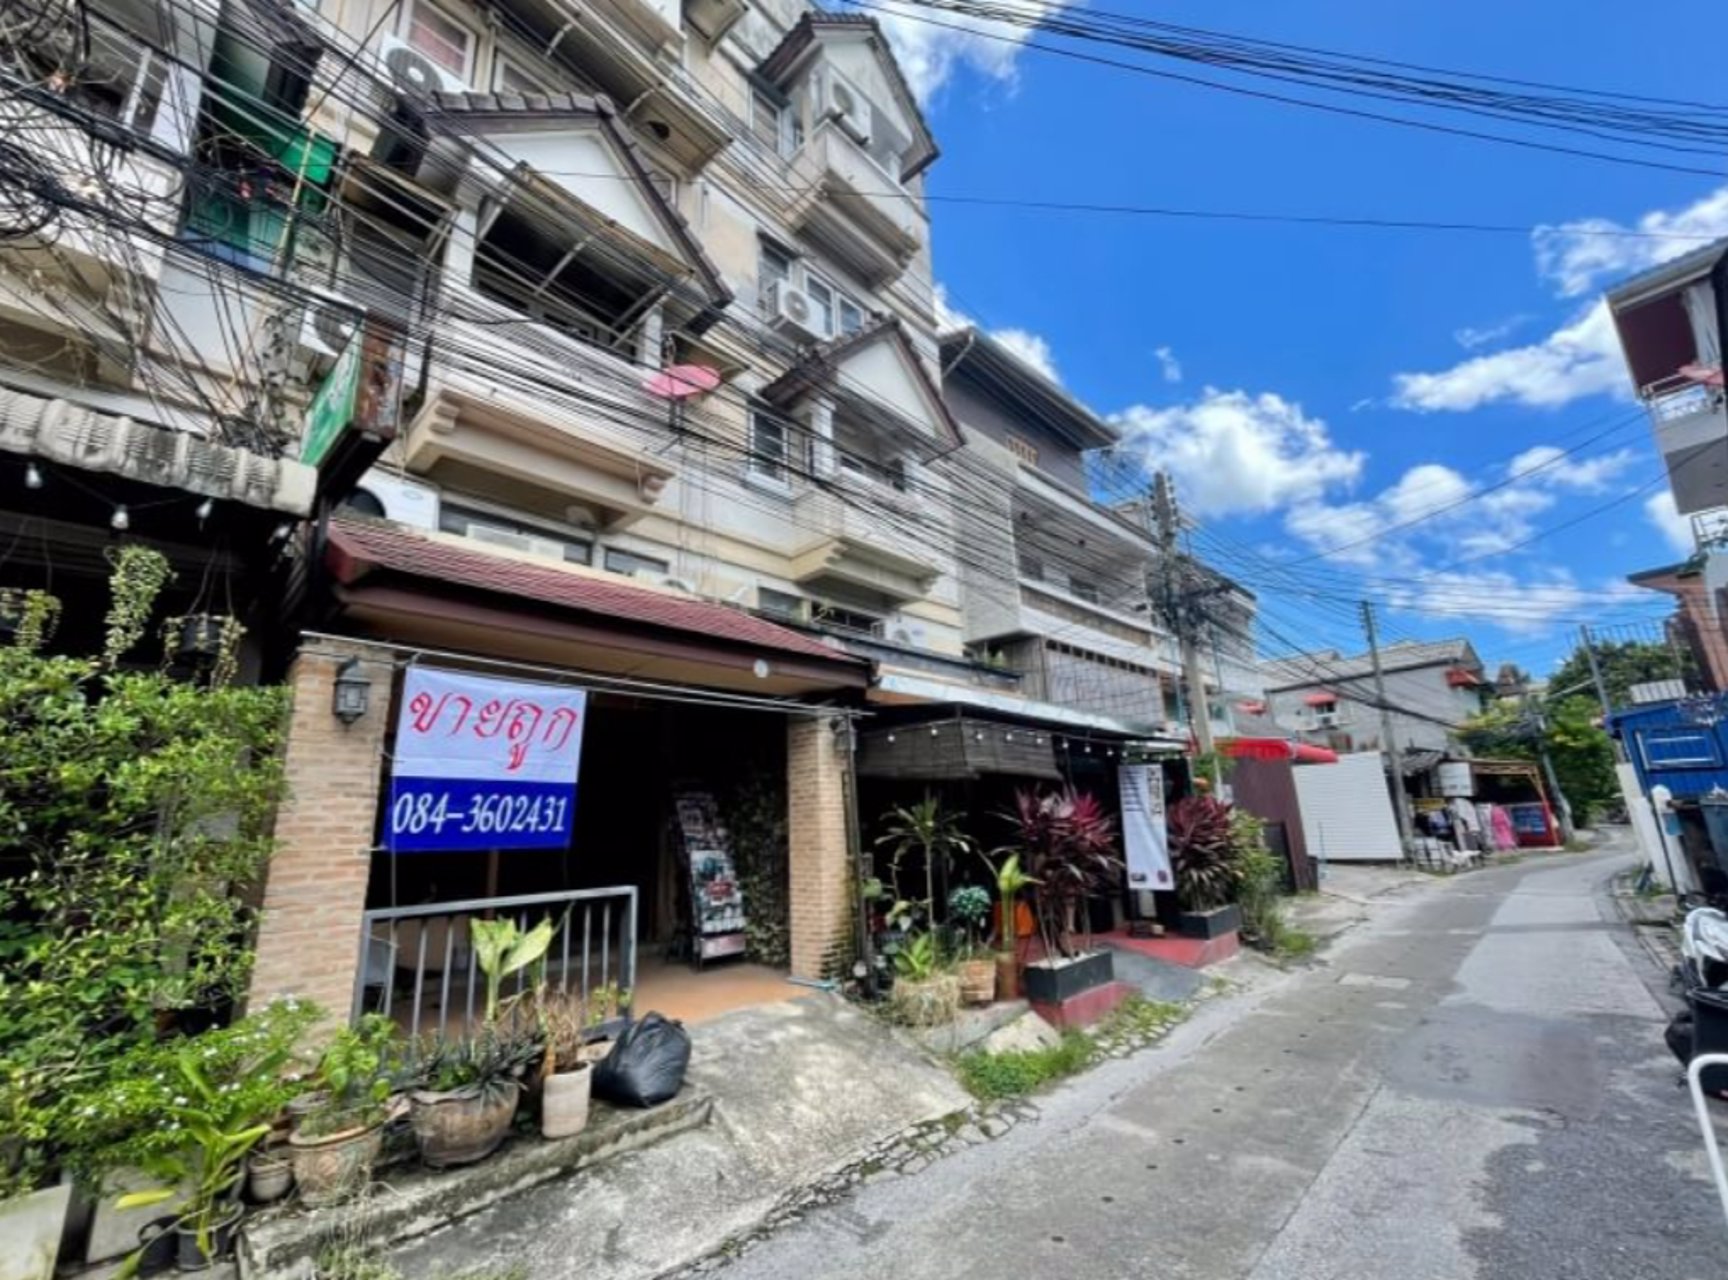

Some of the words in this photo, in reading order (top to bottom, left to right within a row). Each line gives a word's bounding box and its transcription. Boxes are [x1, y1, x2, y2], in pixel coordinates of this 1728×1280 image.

[408, 691, 578, 770] ขายถูก
[391, 792, 568, 834] 084-3602431
